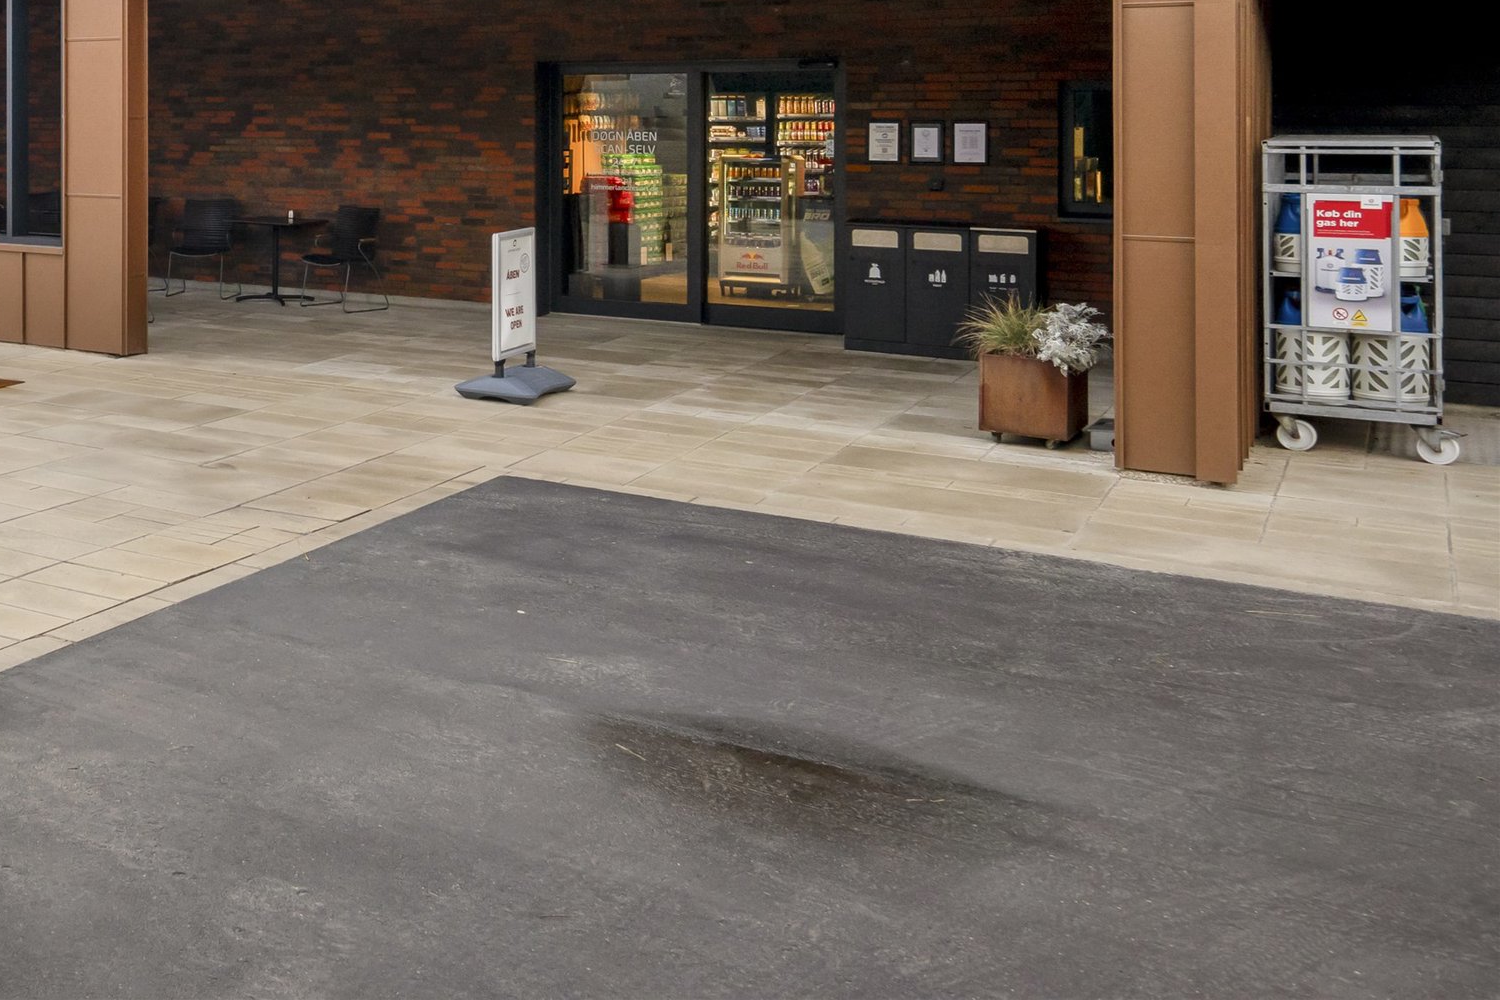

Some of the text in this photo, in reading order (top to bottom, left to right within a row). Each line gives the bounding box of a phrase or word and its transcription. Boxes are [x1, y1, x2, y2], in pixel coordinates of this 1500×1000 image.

[592, 129, 657, 141] DØGN ÅBEN
[594, 144, 656, 154] CAN-SELV
[1316, 209, 1362, 218] Køb din
[1316, 219, 1359, 228] gas her
[736, 262, 769, 270] Red Bull
[506, 269, 520, 281] ÅBEN
[510, 319, 523, 330] OPEN
